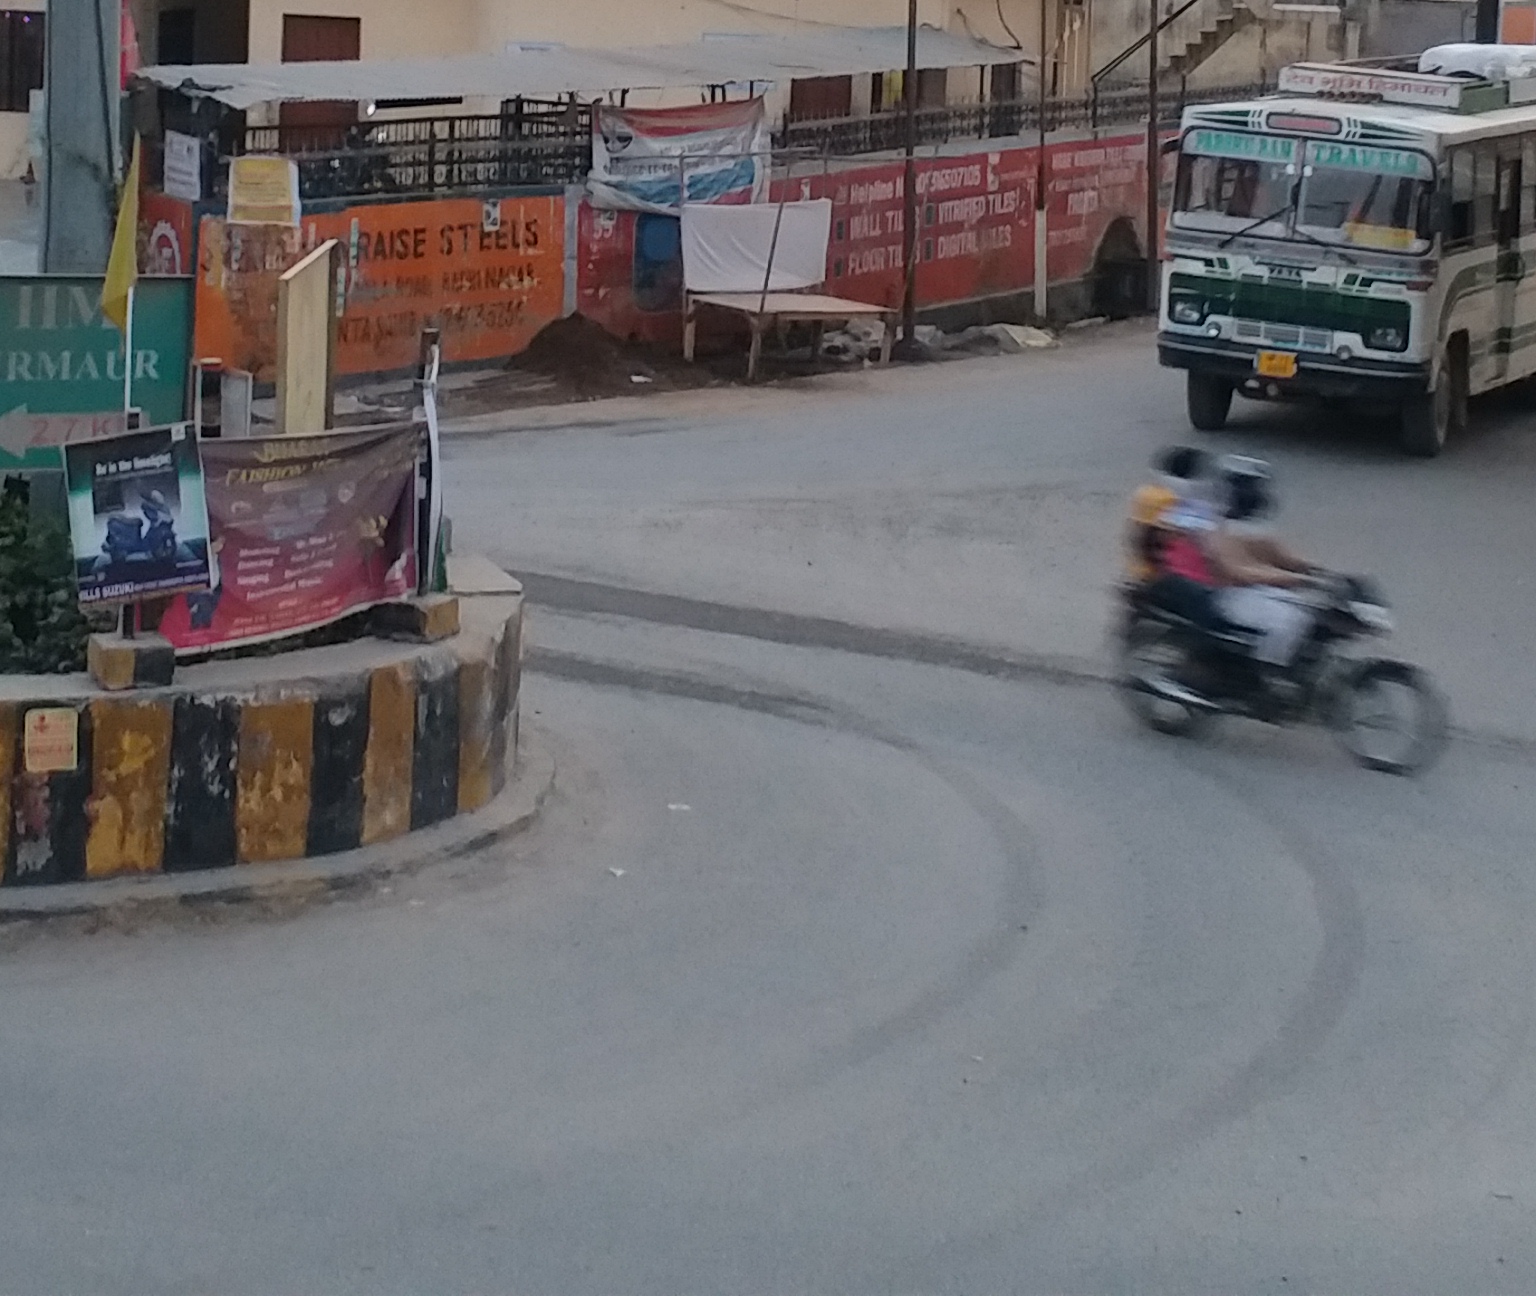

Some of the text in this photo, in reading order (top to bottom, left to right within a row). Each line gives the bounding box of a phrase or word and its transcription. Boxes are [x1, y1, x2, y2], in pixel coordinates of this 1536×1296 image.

[440, 216, 540, 258] STEELS
[850, 212, 882, 241] WALL
[886, 206, 920, 234] TILS
[988, 191, 1017, 219] TILES
[888, 241, 921, 269] TILS
[16, 284, 128, 331] IIM
